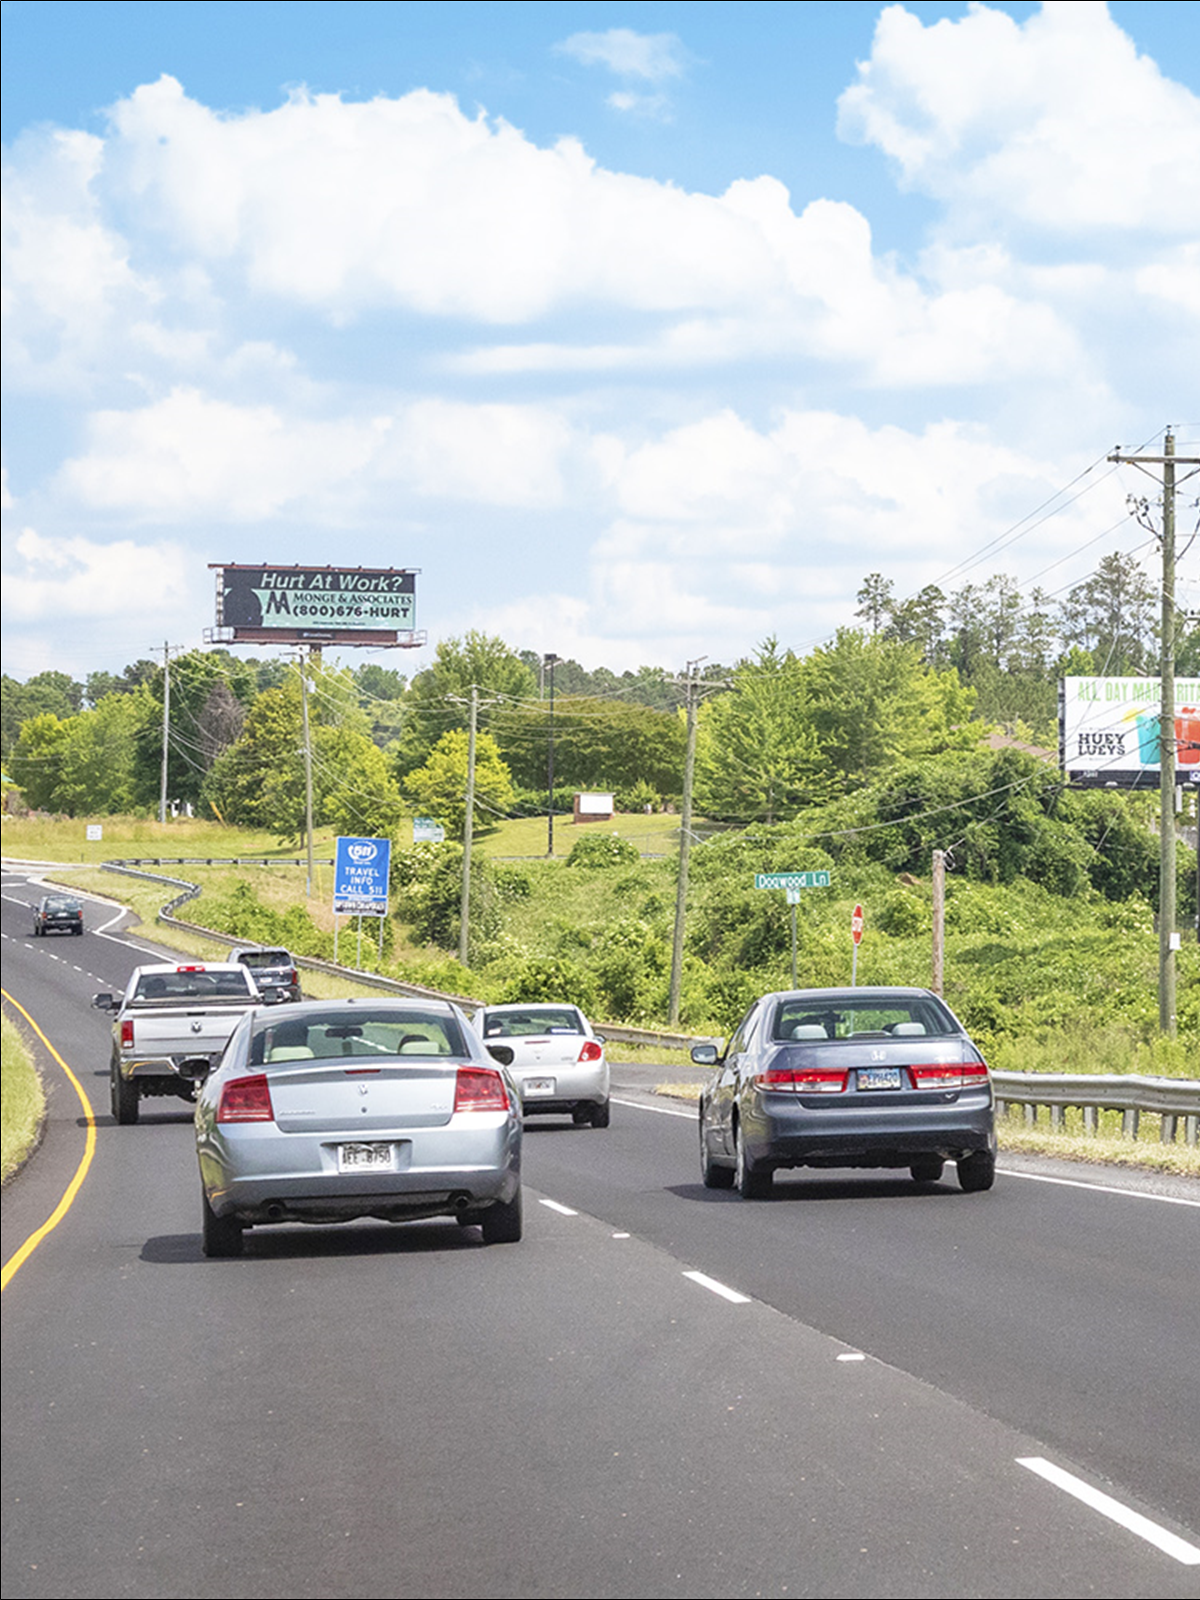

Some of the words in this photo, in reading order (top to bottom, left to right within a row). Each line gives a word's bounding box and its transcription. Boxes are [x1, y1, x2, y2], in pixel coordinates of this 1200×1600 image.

[260, 573, 305, 588] Hurt
[308, 574, 333, 589] At
[338, 575, 403, 591] Work?
[294, 593, 336, 604] MONGE
[338, 593, 347, 604] &
[351, 594, 412, 605] ASSOCIATES
[1078, 682, 1100, 702] ALL
[1105, 682, 1127, 702] DAY
[1078, 733, 1126, 745] HUEY
[345, 866, 380, 877] TRAVEL
[350, 876, 374, 886] INFO
[759, 875, 806, 889] Dogwood
[812, 873, 826, 886] Ln
[340, 884, 364, 895] CALL
[368, 885, 383, 895] 511
